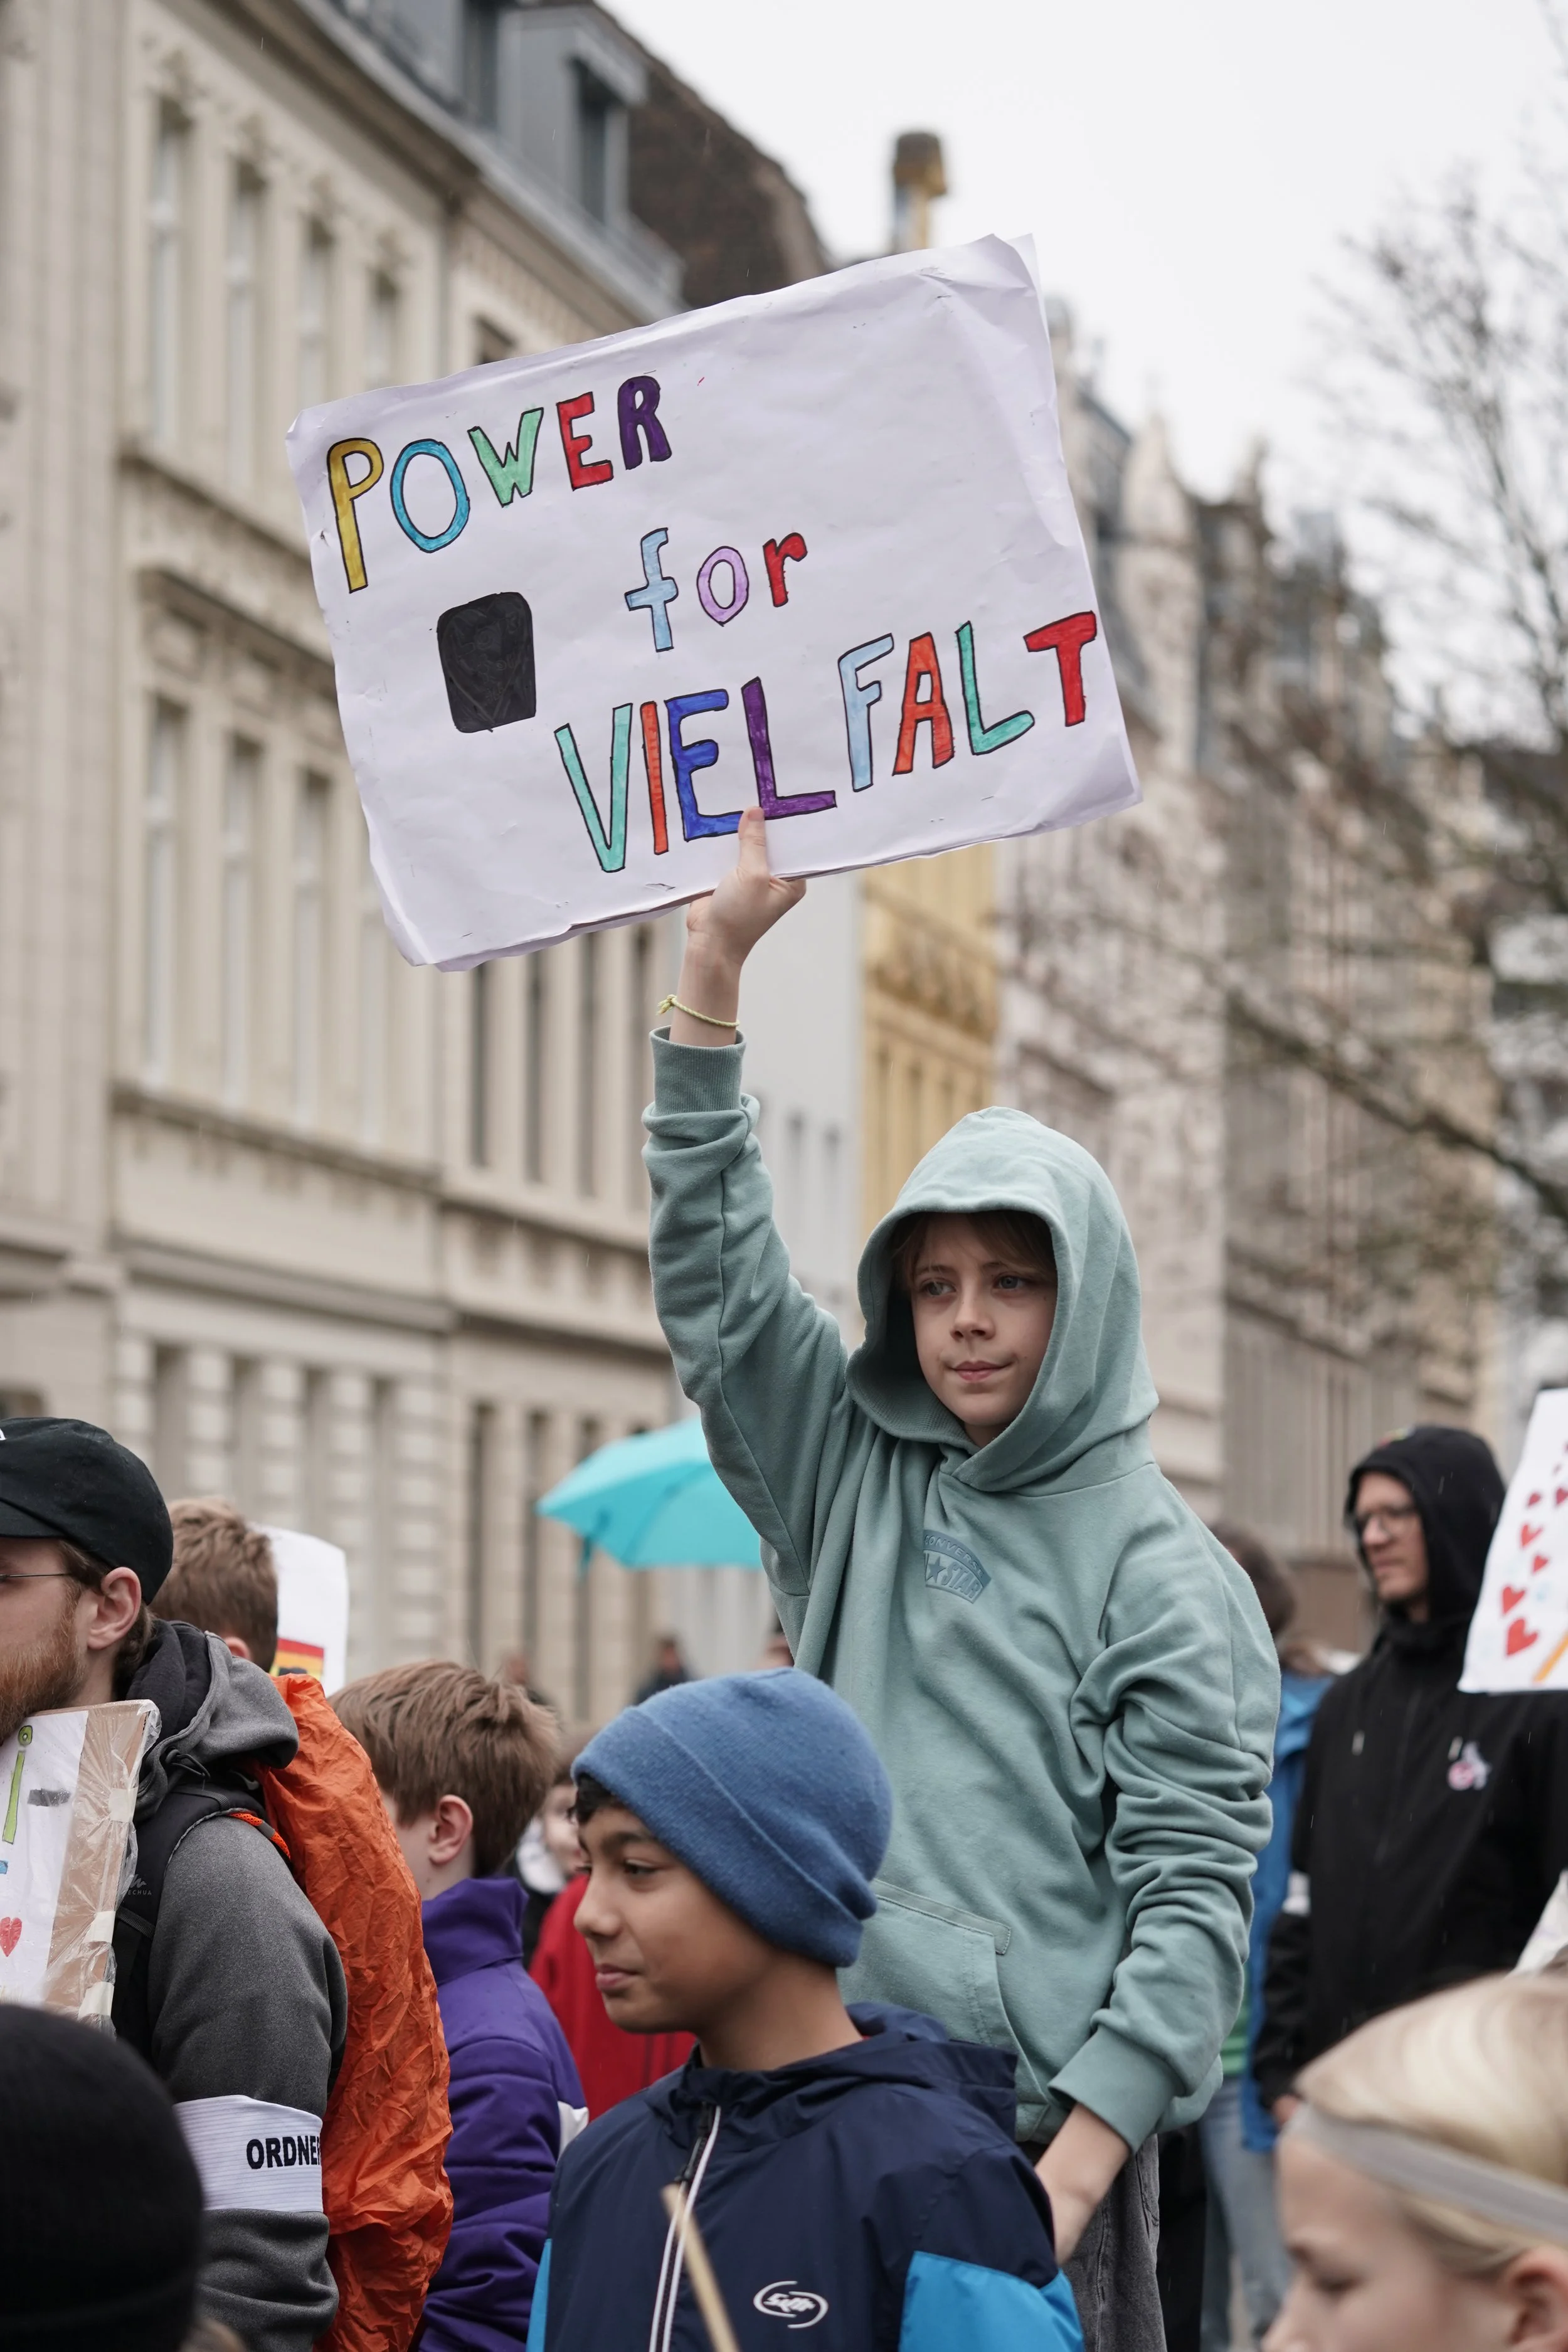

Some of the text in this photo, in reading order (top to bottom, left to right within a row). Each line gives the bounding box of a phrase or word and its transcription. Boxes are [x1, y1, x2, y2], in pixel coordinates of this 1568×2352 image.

[326, 375, 672, 594] POWER
[625, 527, 808, 653] for
[553, 610, 1098, 873] VIELFALT
[924, 1535, 985, 1579] CONVERSE
[941, 1562, 982, 1599] STAR
